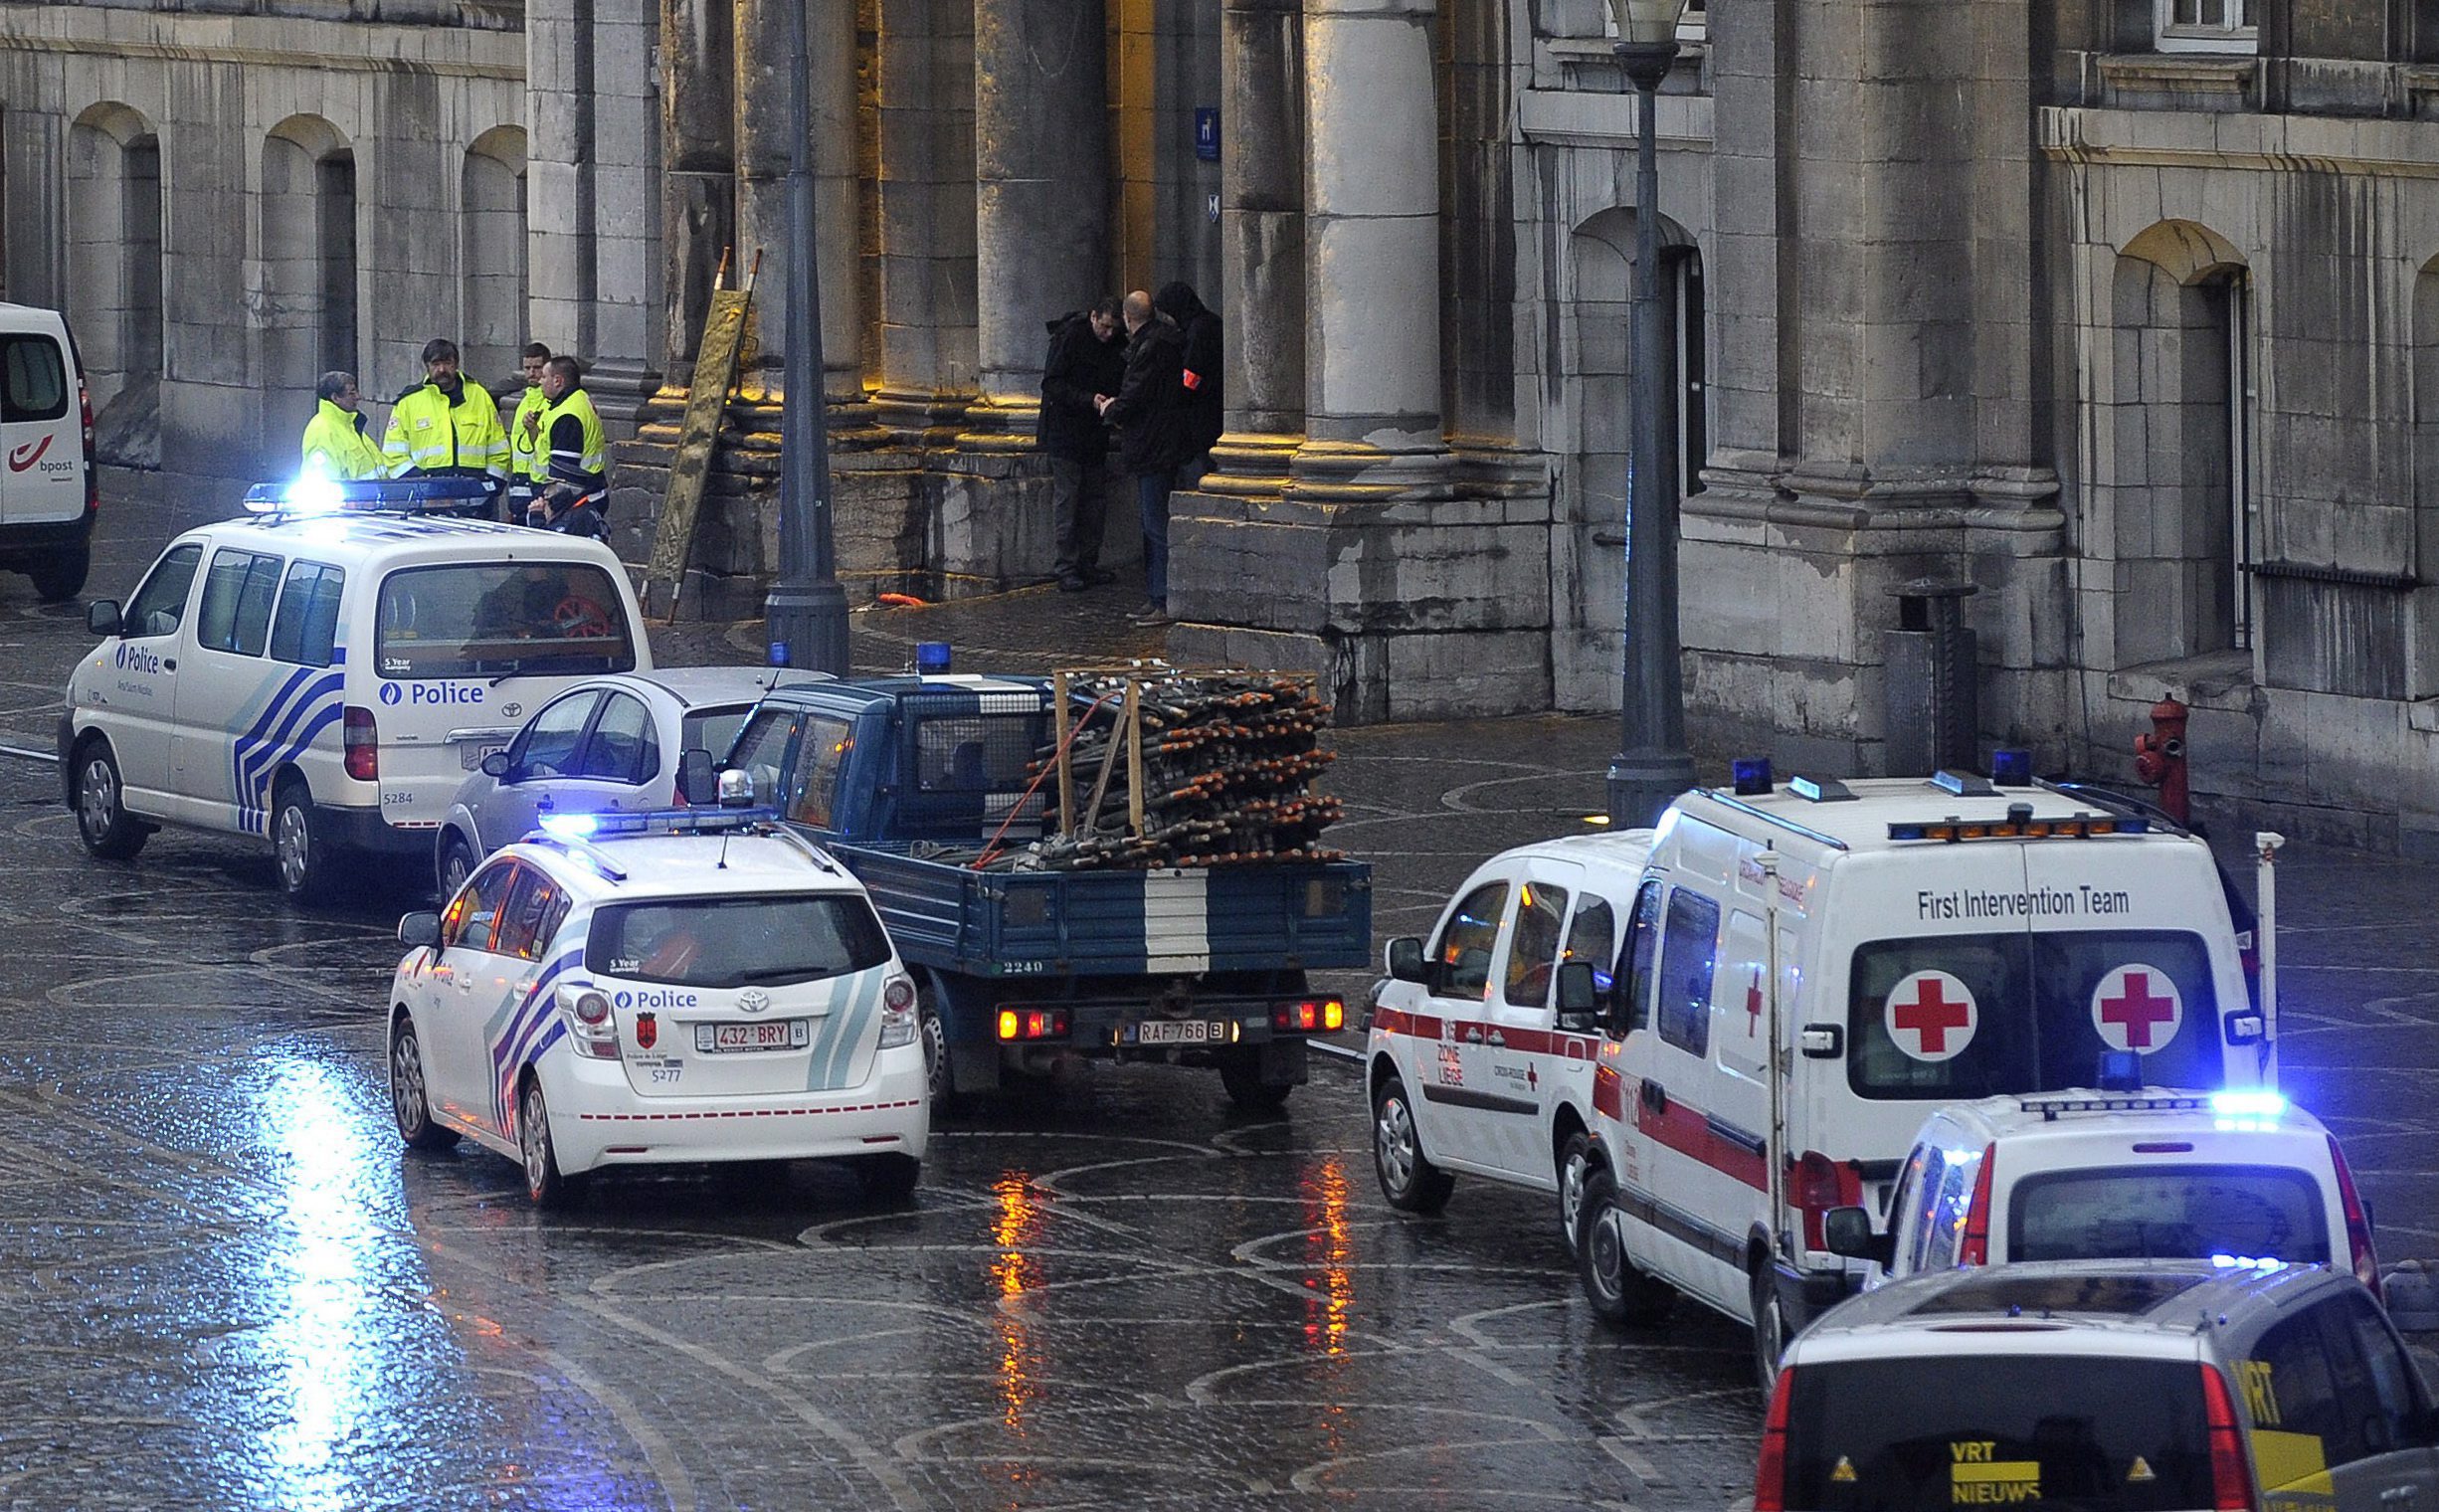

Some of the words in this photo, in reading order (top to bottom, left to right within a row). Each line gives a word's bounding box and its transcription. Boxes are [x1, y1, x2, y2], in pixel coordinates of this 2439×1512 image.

[40, 461, 74, 473] bpost
[127, 646, 158, 674] Police
[413, 681, 483, 704] Police
[384, 793, 413, 804] 5284
[1918, 891, 1960, 919] First
[1964, 886, 2075, 918] Intervention
[2079, 885, 2130, 913] Team
[610, 959, 617, 968] 5
[619, 959, 640, 968] Year
[1004, 961, 1043, 973] 2240
[638, 990, 697, 1008] Police
[719, 1028, 748, 1044] 432
[757, 1026, 785, 1043] BRY
[796, 1028, 804, 1039] B
[1142, 1025, 1170, 1040] RAF
[1176, 1024, 1205, 1039] 766
[1212, 1025, 1221, 1037] B
[1437, 1043, 1460, 1063] ZONE
[652, 1069, 681, 1083] 5277
[2227, 1358, 2281, 1425] VRT
[1951, 1440, 1996, 1462] VRT
[1952, 1481, 2042, 1504] NIEUWS
